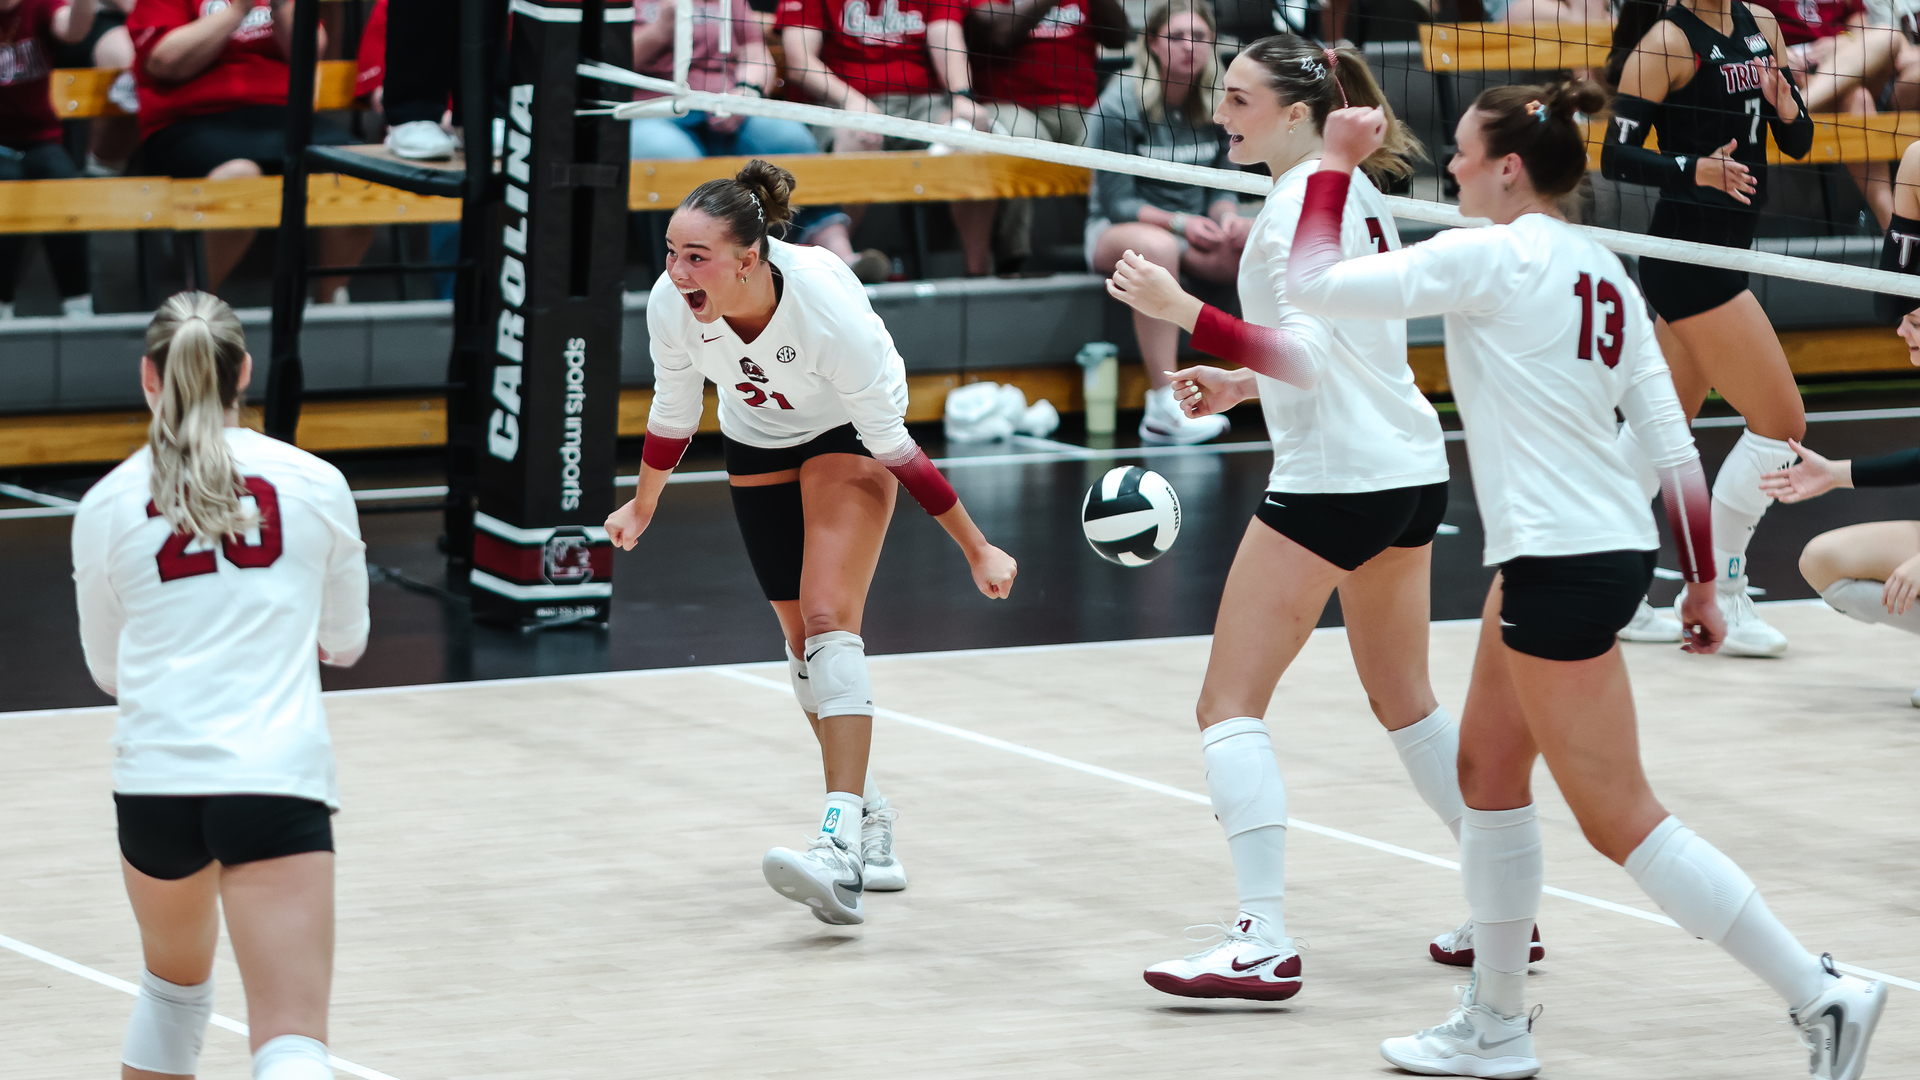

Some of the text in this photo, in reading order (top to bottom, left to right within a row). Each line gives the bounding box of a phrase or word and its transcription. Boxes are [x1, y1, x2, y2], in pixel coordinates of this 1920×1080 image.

[1744, 97, 1760, 144] 7
[488, 84, 534, 461] CAROLINA
[777, 346, 796, 363] SEC
[1573, 270, 1626, 369] 13
[559, 337, 586, 511] sports imports
[735, 382, 795, 410] 21
